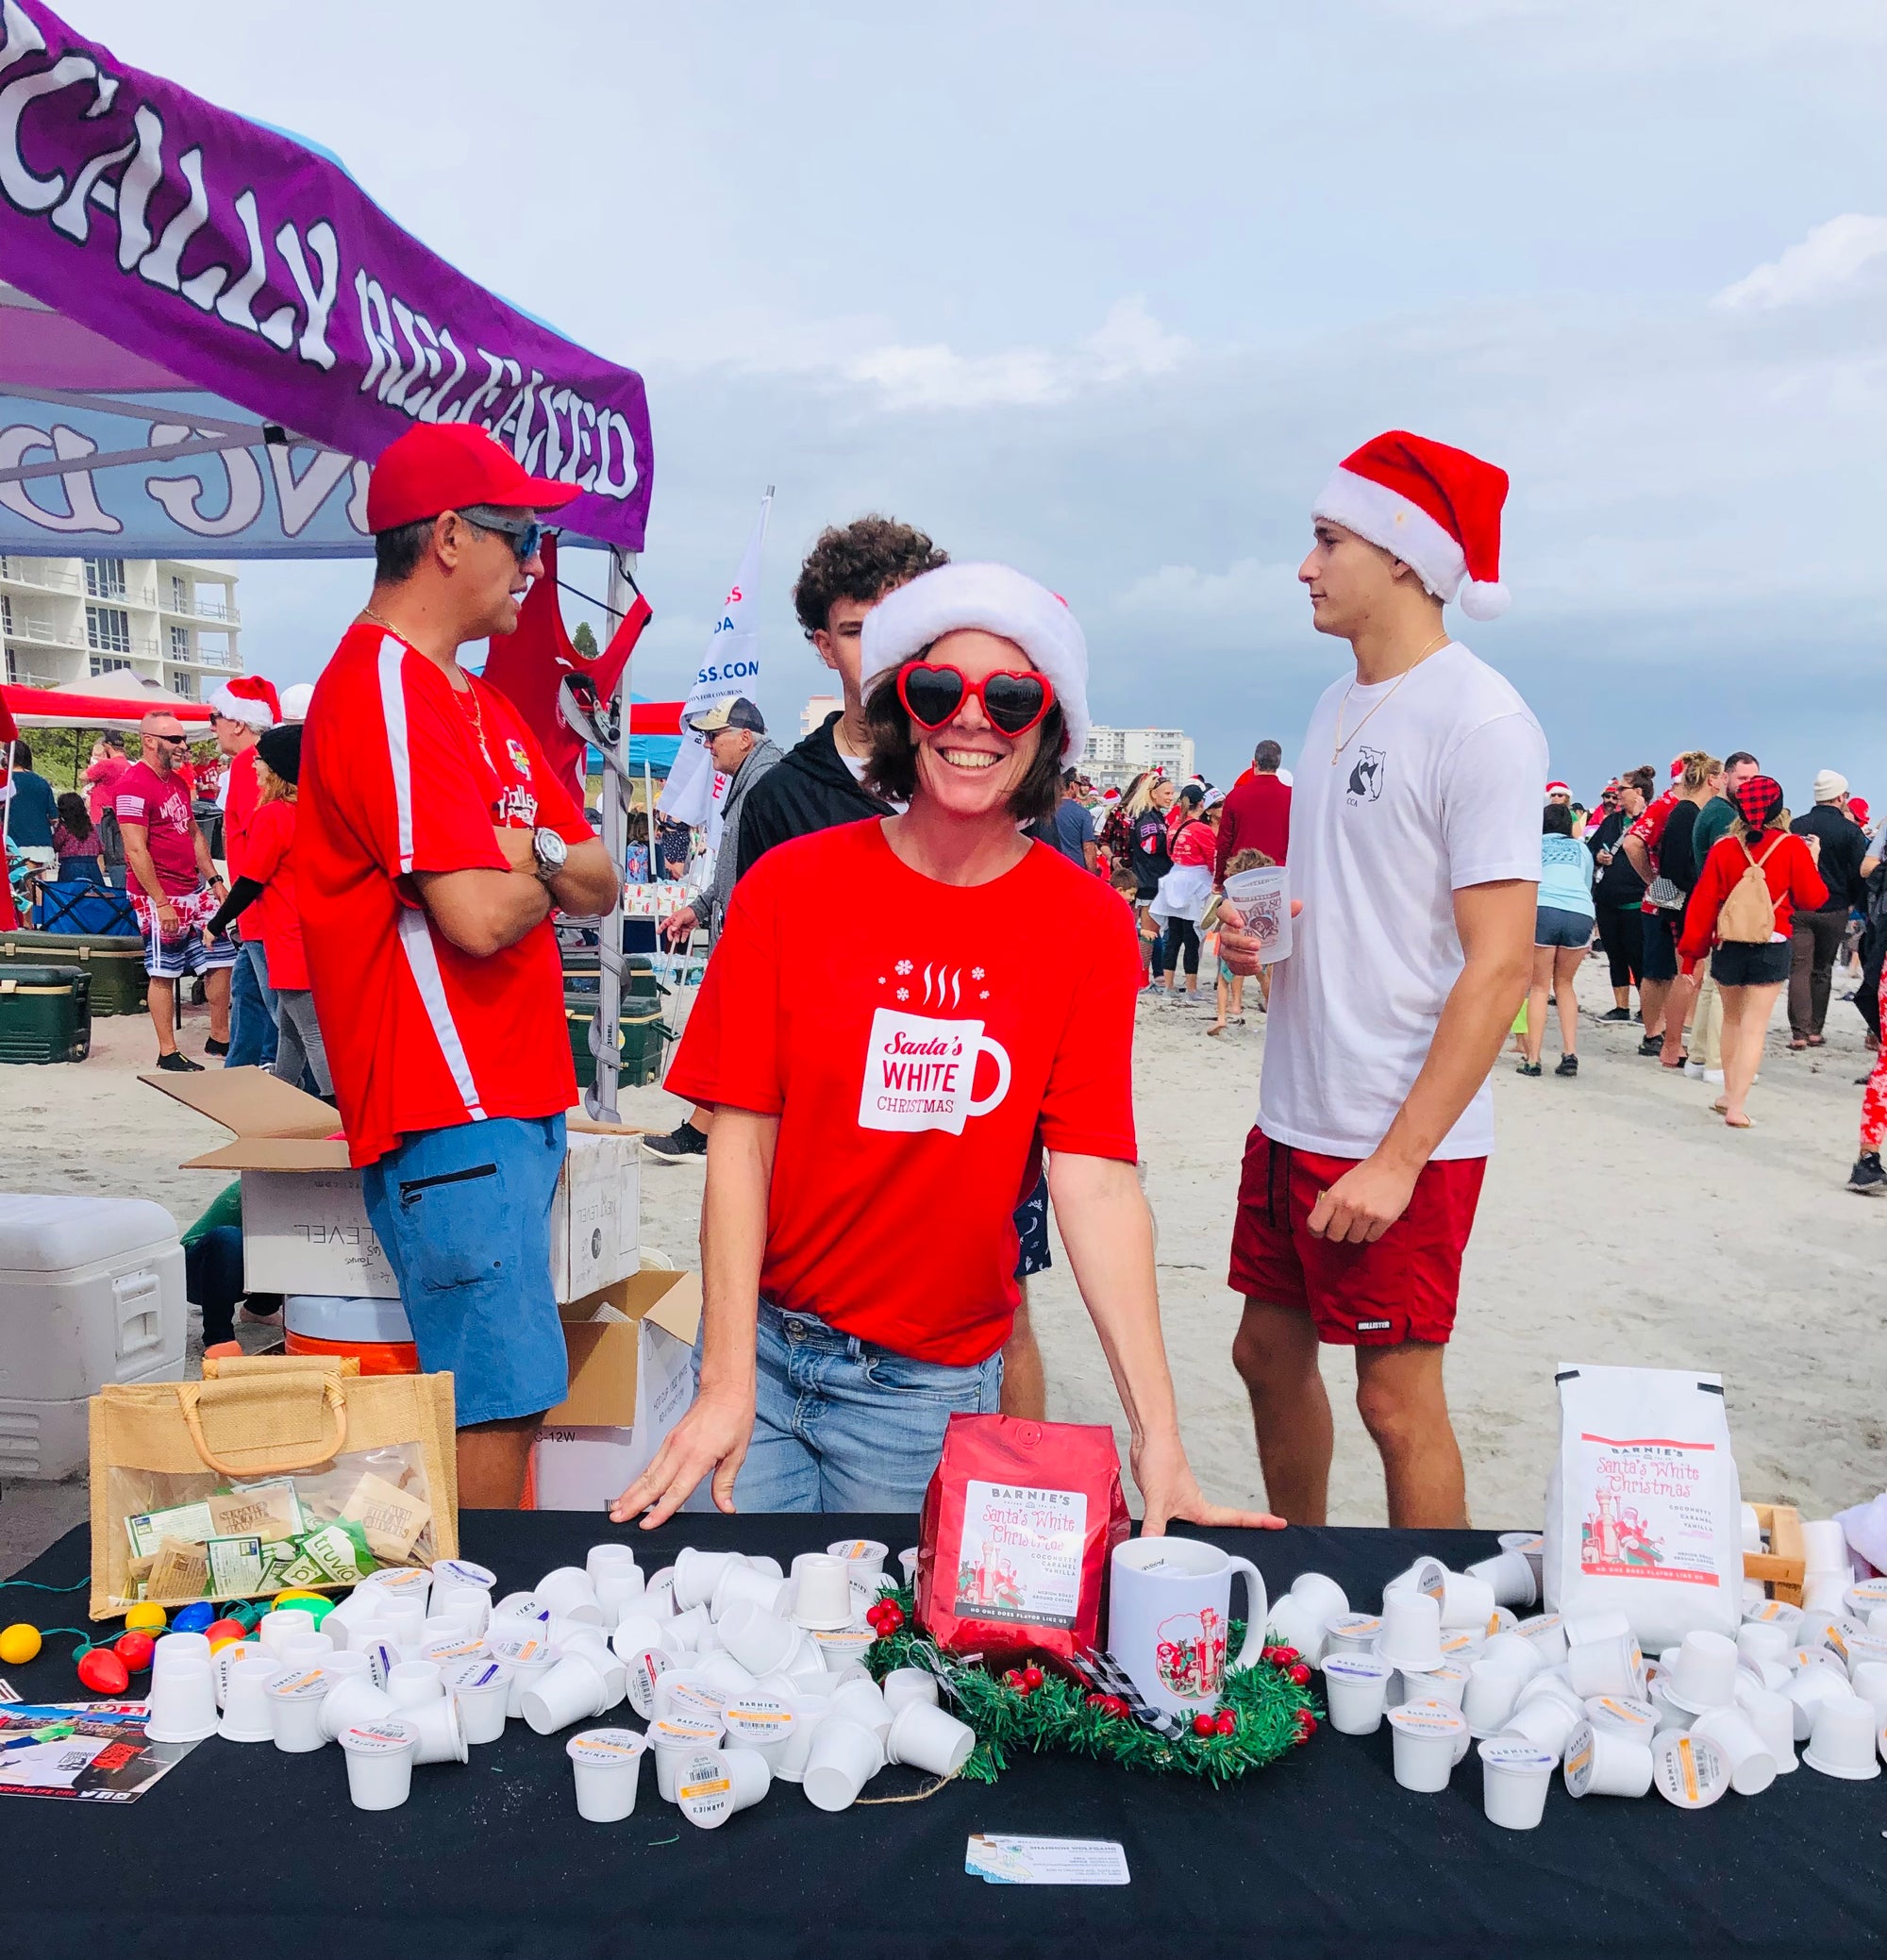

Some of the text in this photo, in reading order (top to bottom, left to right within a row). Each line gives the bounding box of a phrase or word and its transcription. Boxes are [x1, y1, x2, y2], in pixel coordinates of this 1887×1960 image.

[712, 689, 743, 699] CONGRESS
[883, 1031, 963, 1056] Santa's
[882, 1060, 960, 1093] WHITE
[877, 1096, 954, 1114] CHRISTMAS
[293, 1225, 375, 1246] LEVEL
[1358, 1320, 1390, 1331] HOLLISTER
[1611, 1447, 1683, 1458] BARNIE'S
[1596, 1457, 1700, 1481] Santa's White
[1605, 1473, 1692, 1498] Christmas
[992, 1488, 1070, 1505] BARNIE'S
[982, 1504, 1076, 1532] Santa's White
[1679, 1514, 1712, 1525] CARAMEL
[1683, 1522, 1714, 1533] VANILLA
[1030, 1552, 1077, 1564] COCONUTTY
[1042, 1561, 1077, 1570] CARAMEL
[1044, 1567, 1077, 1576] VANILLA
[1016, 1613, 1041, 1621] FLAVOR
[739, 1700, 780, 1709] BARNIE'S
[676, 1717, 714, 1729] BARNIE'S
[1665, 1751, 1678, 1793] BARNIE'S
[693, 1801, 725, 1814] BARNIE'S
